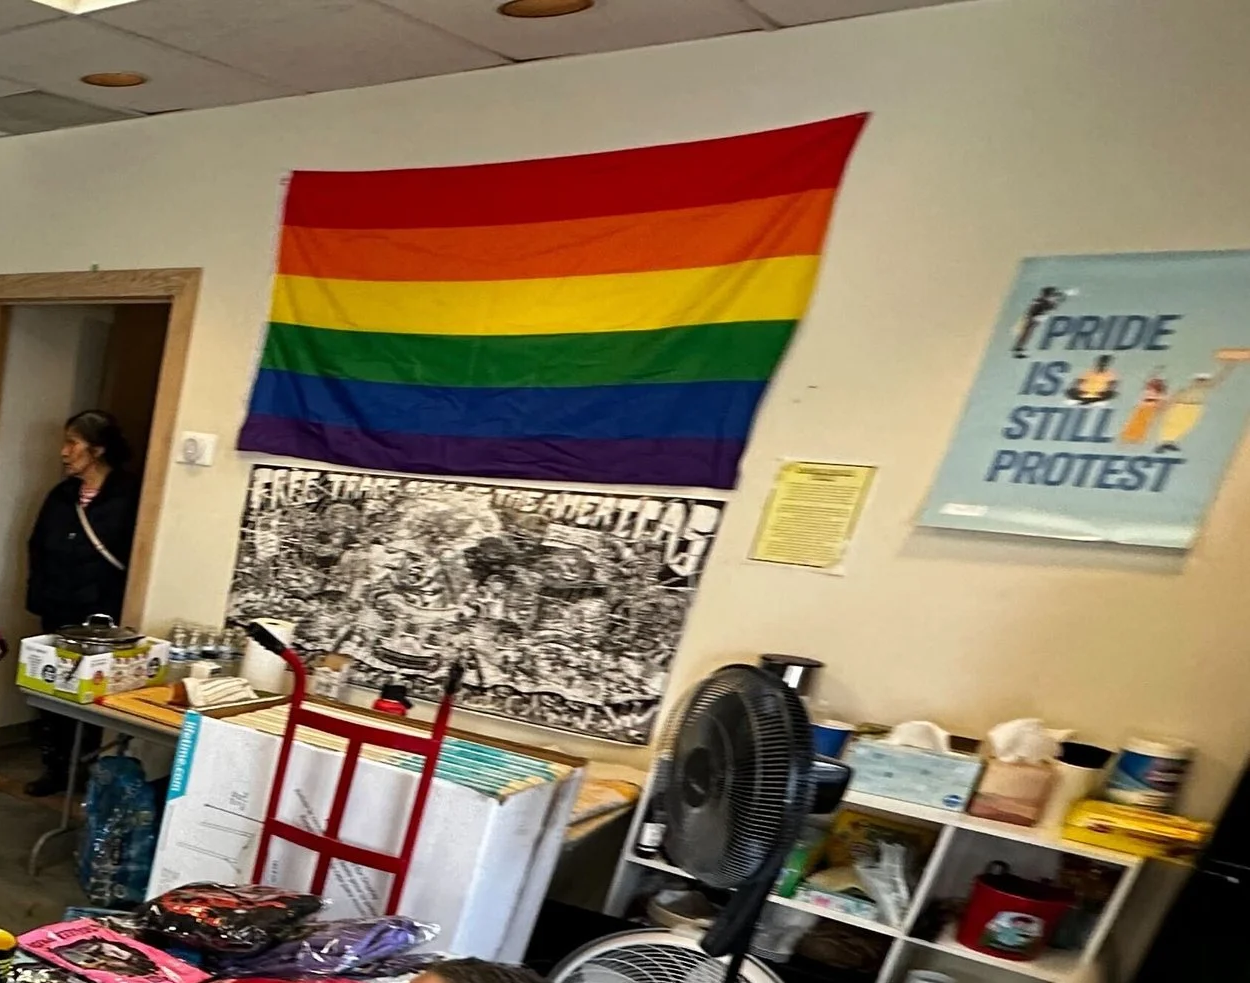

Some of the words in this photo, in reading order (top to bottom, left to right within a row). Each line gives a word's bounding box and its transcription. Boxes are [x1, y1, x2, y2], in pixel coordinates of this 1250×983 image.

[1038, 314, 1184, 351] PRIDE
[1017, 360, 1072, 397] IS
[1002, 405, 1117, 444] STILL
[251, 467, 321, 510] FREE
[983, 449, 1188, 493] PROTEST
